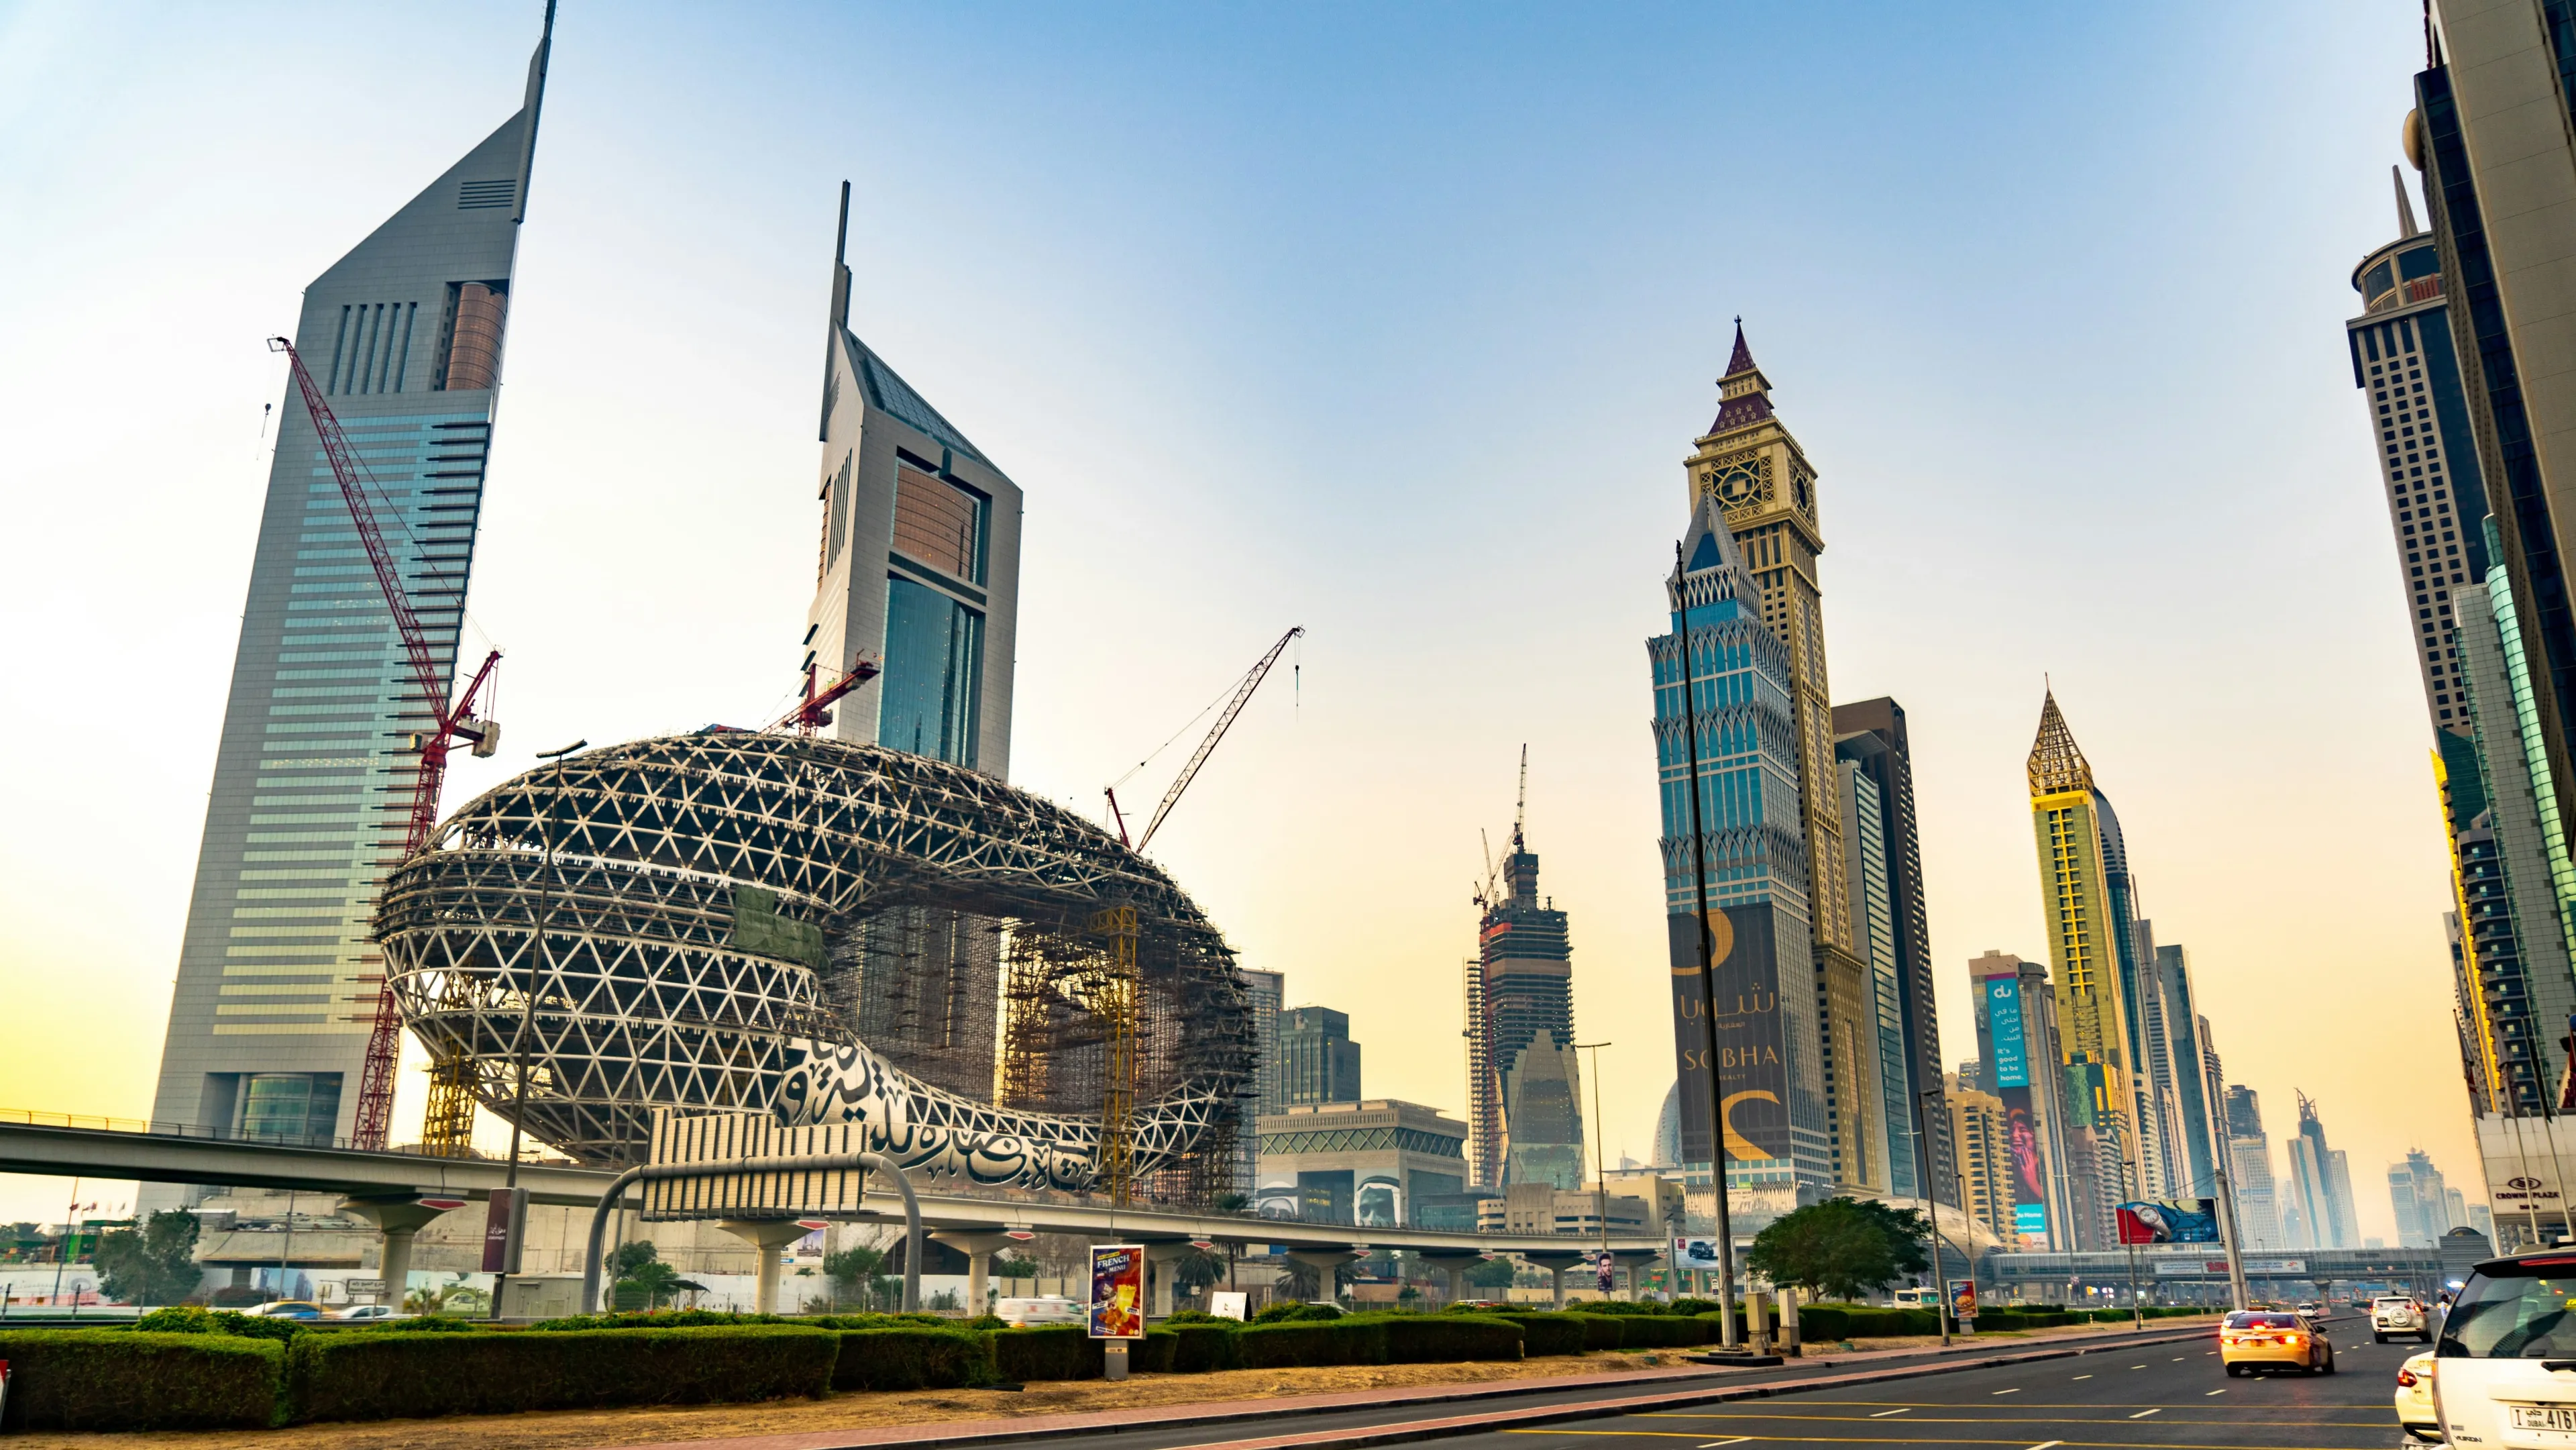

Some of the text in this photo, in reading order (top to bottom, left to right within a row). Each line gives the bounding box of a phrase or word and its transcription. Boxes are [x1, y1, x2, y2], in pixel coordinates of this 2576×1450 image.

[1994, 984, 2012, 998] du
[1998, 1055, 2018, 1064] good
[1097, 1254, 1130, 1268] FRENCH
[1109, 1264, 1126, 1272] MENU
[2527, 1419, 2544, 1428] DUBAI
